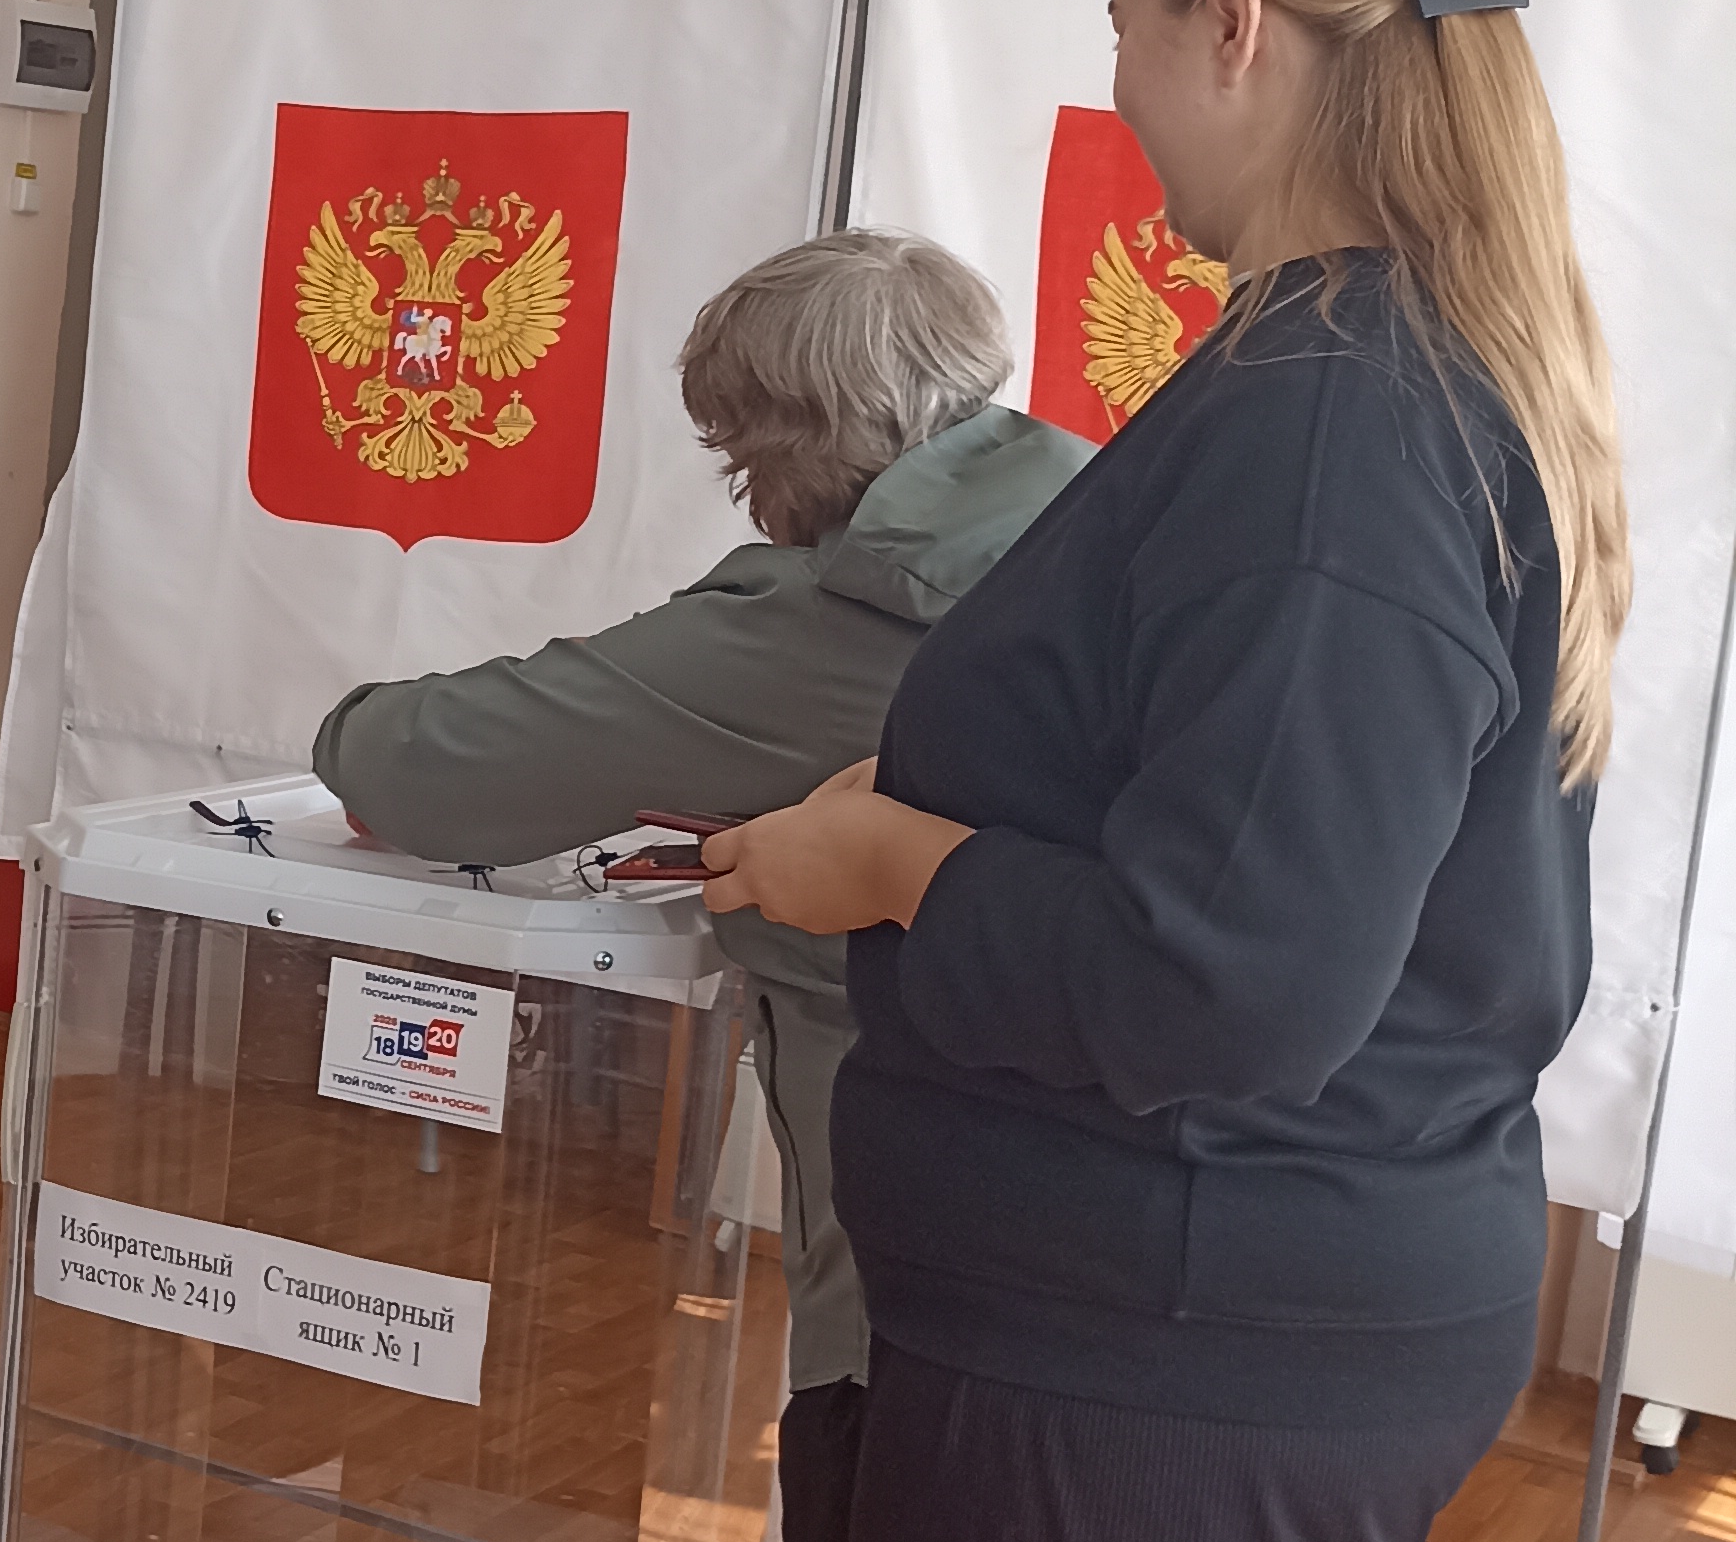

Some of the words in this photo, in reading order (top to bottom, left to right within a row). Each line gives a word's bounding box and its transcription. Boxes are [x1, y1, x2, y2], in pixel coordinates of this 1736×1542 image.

[361, 987, 448, 1011] ГОСУДАРСТВЕННОЙ
[365, 971, 412, 989] ВЫБОРЫ
[413, 980, 477, 1001] ДЕПУТАТОВ
[374, 1035, 395, 1057] 18
[400, 1030, 423, 1052] 19
[427, 1026, 457, 1049] 20
[332, 1072, 359, 1087] ТВОЙ
[361, 1079, 397, 1096] ГОЛОС
[400, 1059, 456, 1079] СЕНТЯБРЯ
[60, 1214, 234, 1278] Избирательный
[59, 1257, 145, 1296] участок
[151, 1274, 177, 1303] №
[183, 1282, 237, 1316] 2419
[263, 1265, 455, 1334] Стационарный
[297, 1318, 366, 1355] ящик
[372, 1331, 402, 1362] №
[411, 1341, 420, 1366] 1
